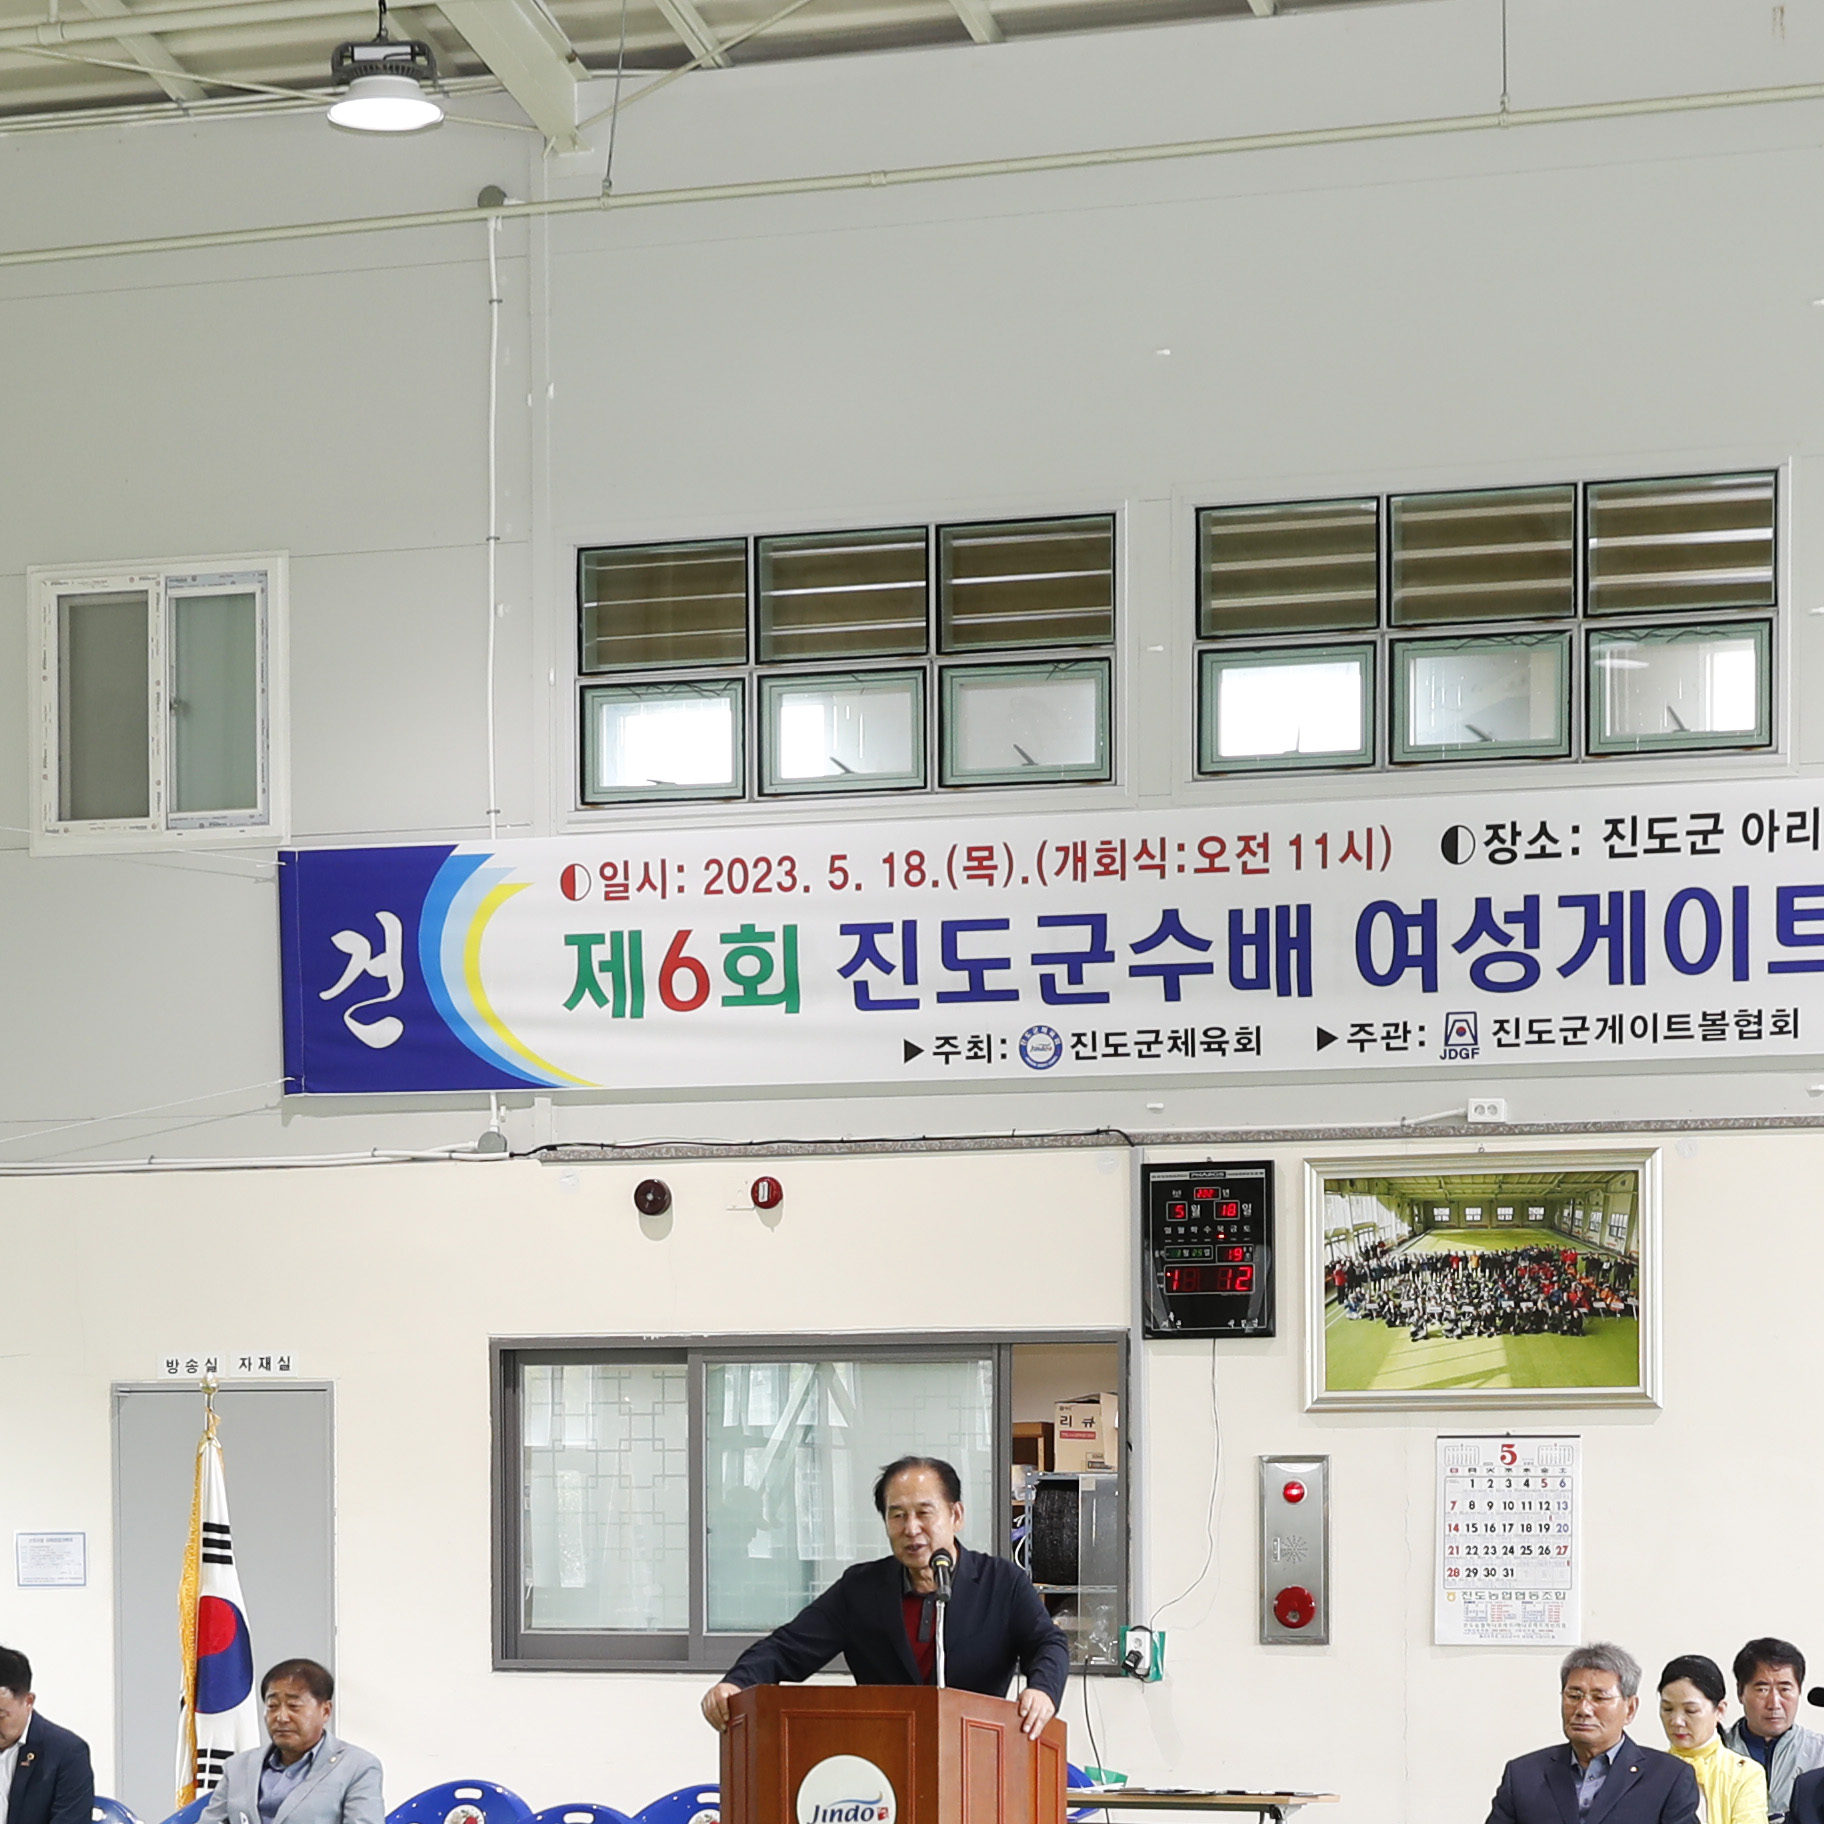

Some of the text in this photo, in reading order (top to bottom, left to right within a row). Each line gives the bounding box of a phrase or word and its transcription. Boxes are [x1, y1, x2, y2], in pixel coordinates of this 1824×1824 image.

[600, 859, 684, 901] 일시:
[704, 856, 810, 895] 2023.
[829, 855, 861, 891] 5.
[1289, 825, 1391, 871] 11시)
[1484, 821, 1579, 865] 장소:
[1603, 813, 1724, 858] 진도군
[563, 924, 800, 1018] 제6회
[837, 904, 1312, 1011] 진도군수배
[933, 1034, 1006, 1065] 주최:
[1071, 1026, 1260, 1060] 진도군체육회
[1347, 1021, 1425, 1052] 주관:
[1492, 1008, 1798, 1047] 진도군게이트볼협회
[1439, 1047, 1480, 1060] JDGF
[1174, 1205, 1185, 1218] 5
[1221, 1203, 1236, 1217] 18
[166, 1356, 292, 1374] 방송실 자재실
[1500, 1444, 1517, 1465] 5
[1470, 1479, 1566, 1488] 1 2 3 4 5 6
[1450, 1501, 1568, 1510] 7 8 9 10 11 12 13
[1448, 1524, 1569, 1533] 14 15 16 17 18 19 20
[1448, 1546, 1568, 1555] 21 22 23 24 25 26 27
[1447, 1568, 1514, 1577] 28 29 30 31
[1462, 1591, 1566, 1600] 진도농업협동조합
